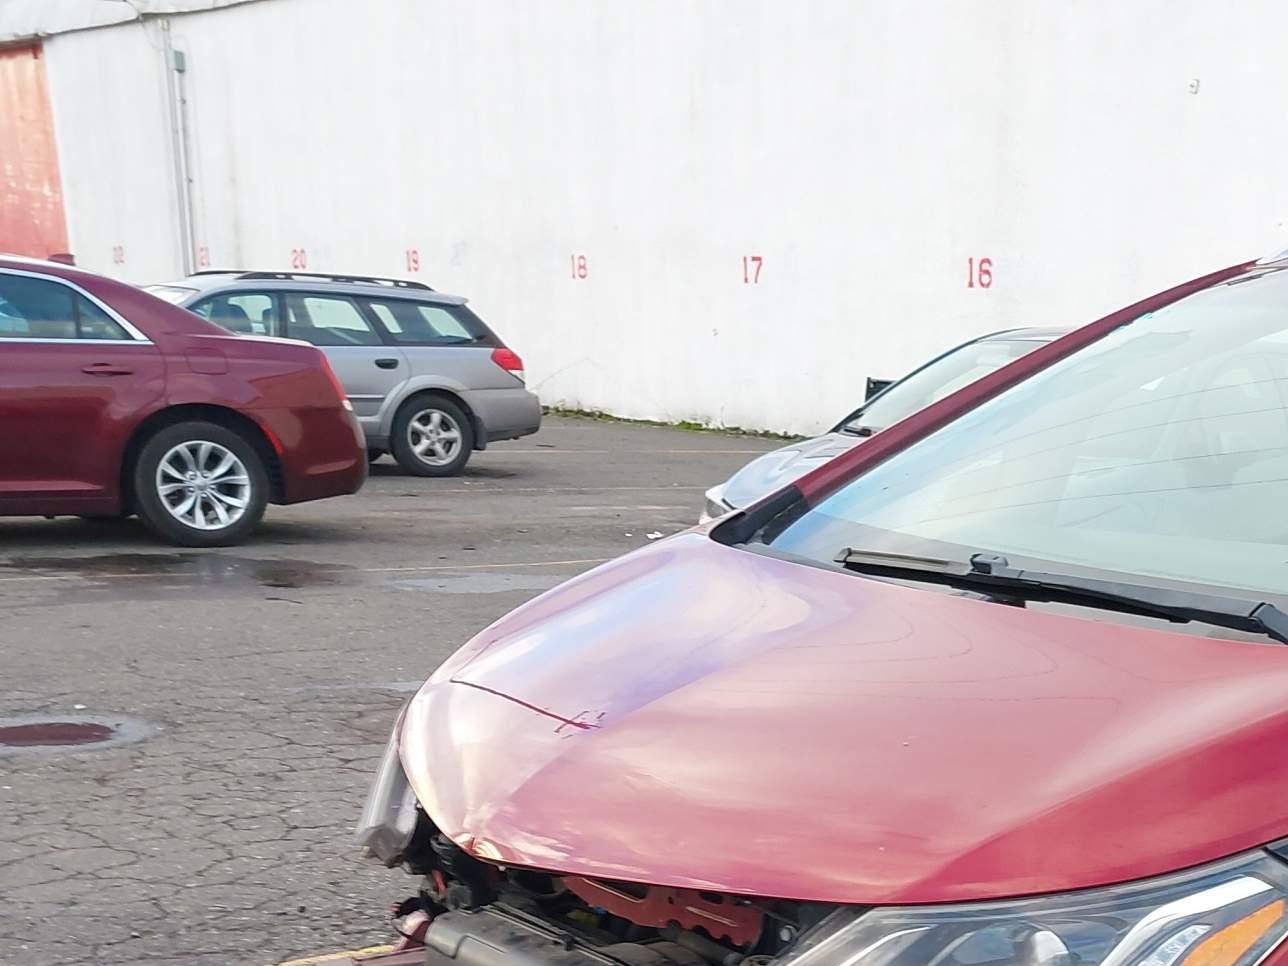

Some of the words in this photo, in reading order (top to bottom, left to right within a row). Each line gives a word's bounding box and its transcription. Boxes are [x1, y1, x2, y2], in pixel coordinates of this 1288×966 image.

[291, 248, 307, 269] 20
[406, 249, 419, 272] 19
[571, 255, 588, 279] 18
[742, 256, 764, 284] 17
[967, 257, 993, 289] 16
